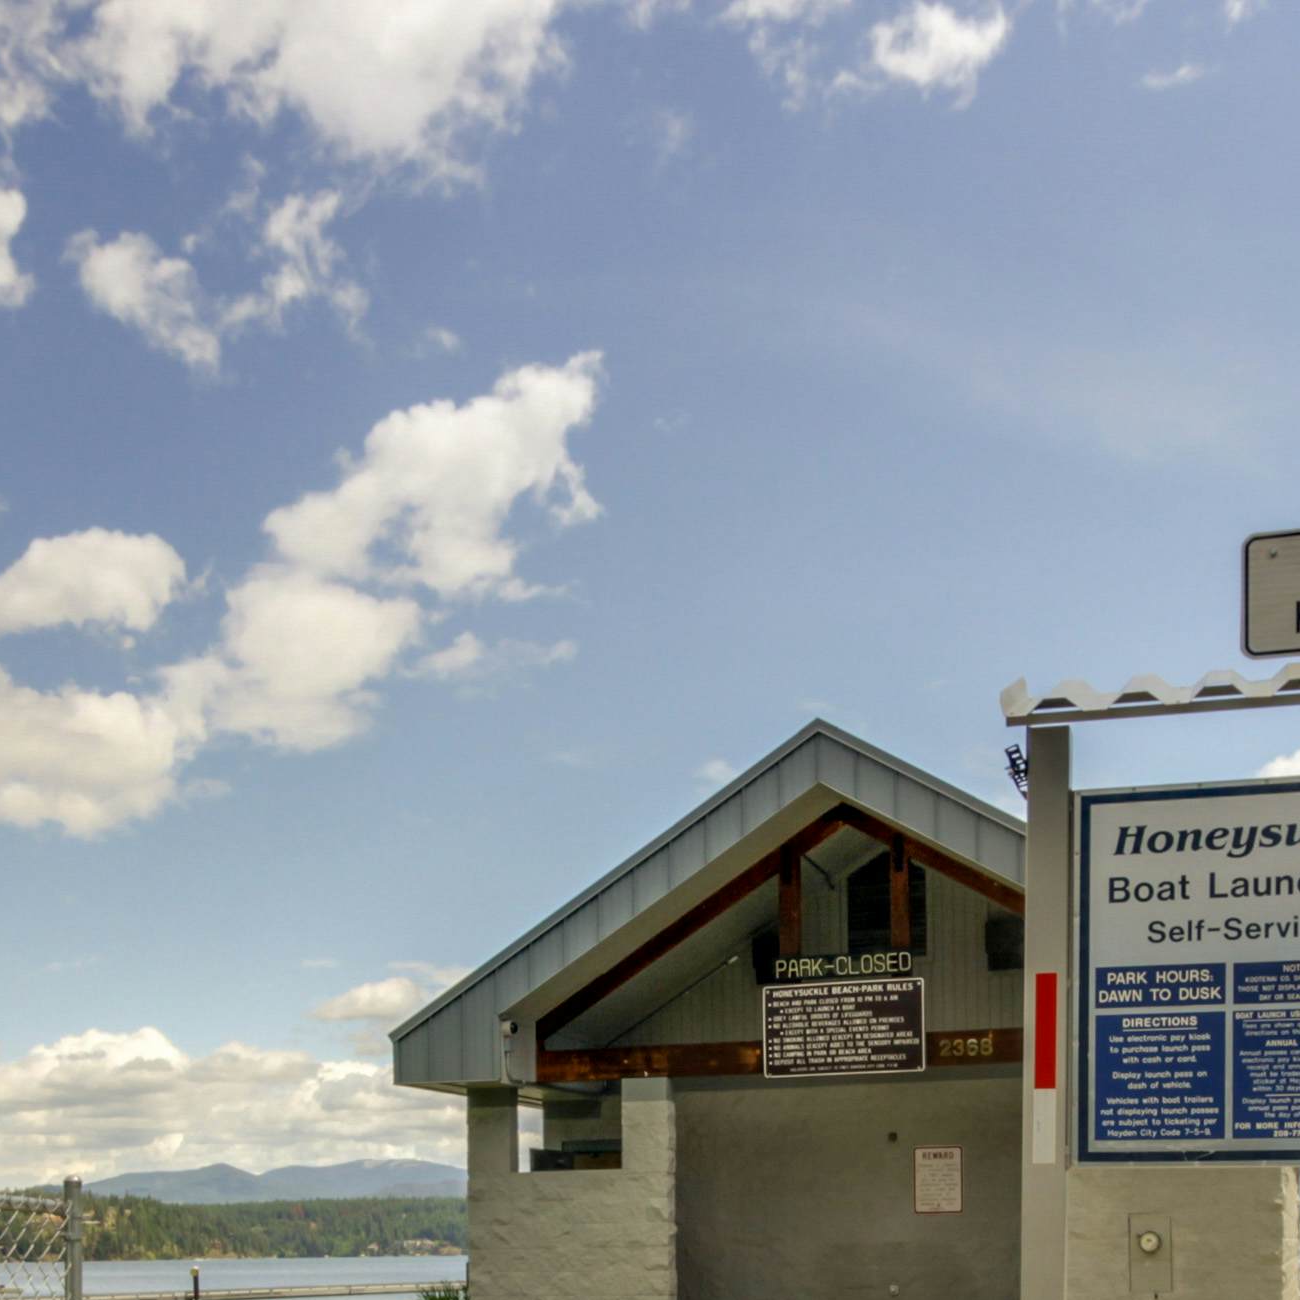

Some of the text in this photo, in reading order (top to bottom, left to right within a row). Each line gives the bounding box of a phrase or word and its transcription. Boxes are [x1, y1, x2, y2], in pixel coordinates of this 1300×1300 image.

[1108, 874, 1190, 903] Boat
[775, 951, 912, 979] PARK-CLOSED
[1107, 969, 1214, 985] PARK HOURS:
[773, 983, 913, 998] HONEYSUCKLE BEACH-PARK RULES
[1099, 986, 1222, 1003] DAWN TO DUSK
[1122, 1016, 1198, 1028] DIRECTIONS
[1236, 1012, 1253, 1020] BOAT
[1257, 1010, 1286, 1018] LAUNCH
[939, 1038, 993, 1057] 2368
[1265, 1038, 1298, 1046] ANNUAL
[1235, 1122, 1251, 1130] FOR
